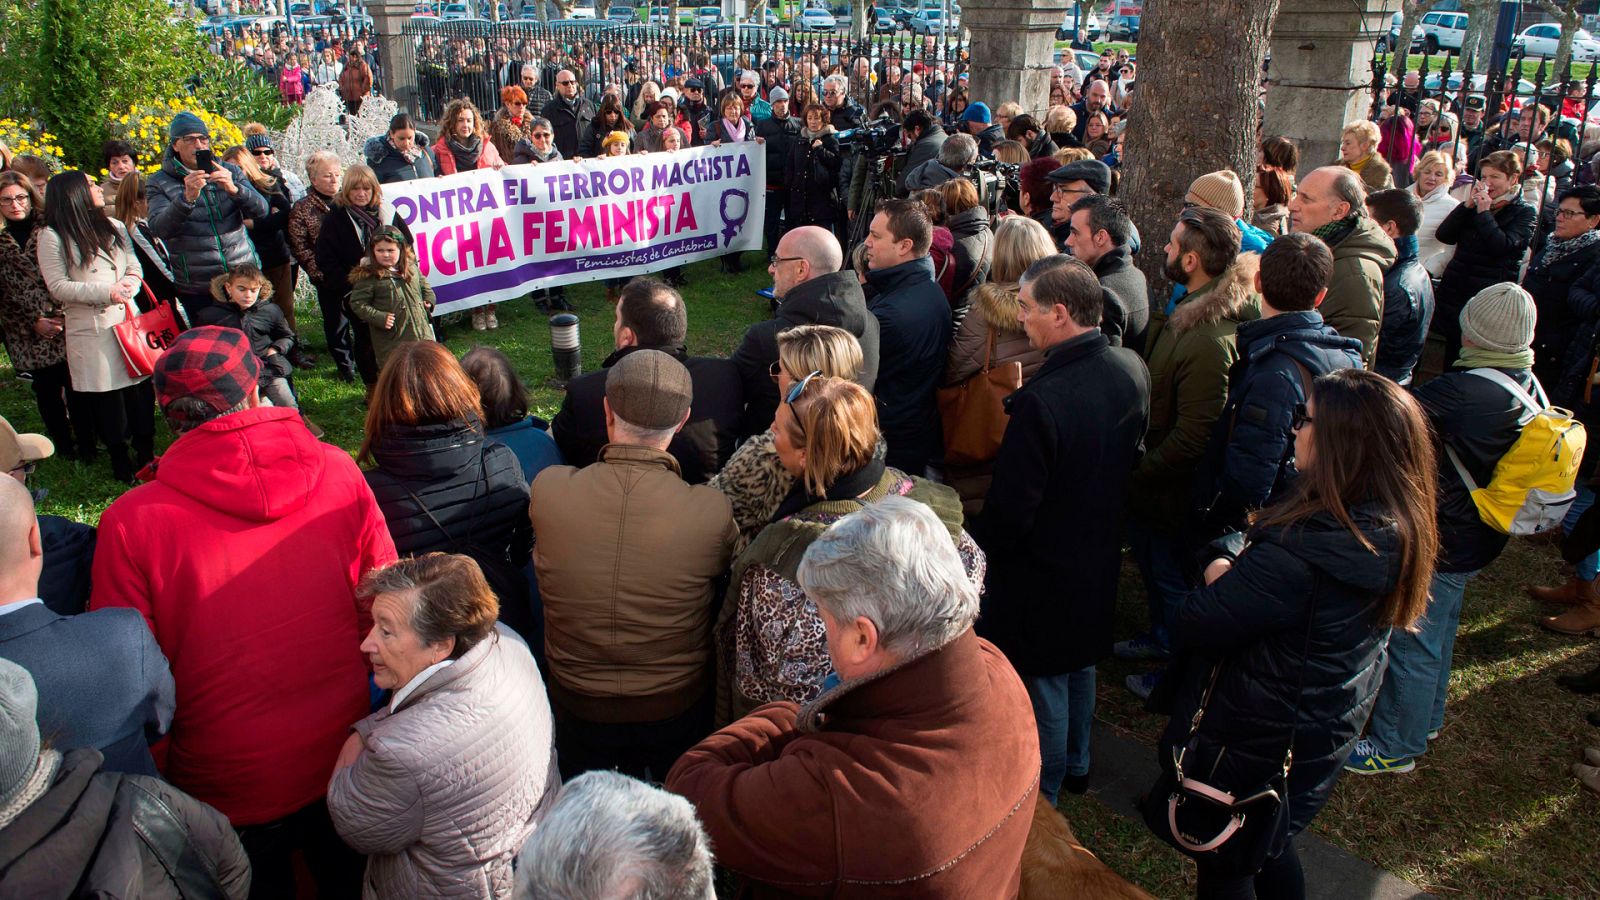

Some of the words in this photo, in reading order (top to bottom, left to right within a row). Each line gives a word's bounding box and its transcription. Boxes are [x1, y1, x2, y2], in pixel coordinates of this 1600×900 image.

[391, 183, 499, 226] ONTRA
[503, 178, 536, 206] EL
[544, 167, 644, 203] TERROR
[652, 154, 751, 189] MACHISTA
[522, 192, 698, 256] FEMINISTA
[576, 253, 648, 270] Feministas
[650, 249, 660, 262] de
[661, 239, 715, 258] Cantabria
